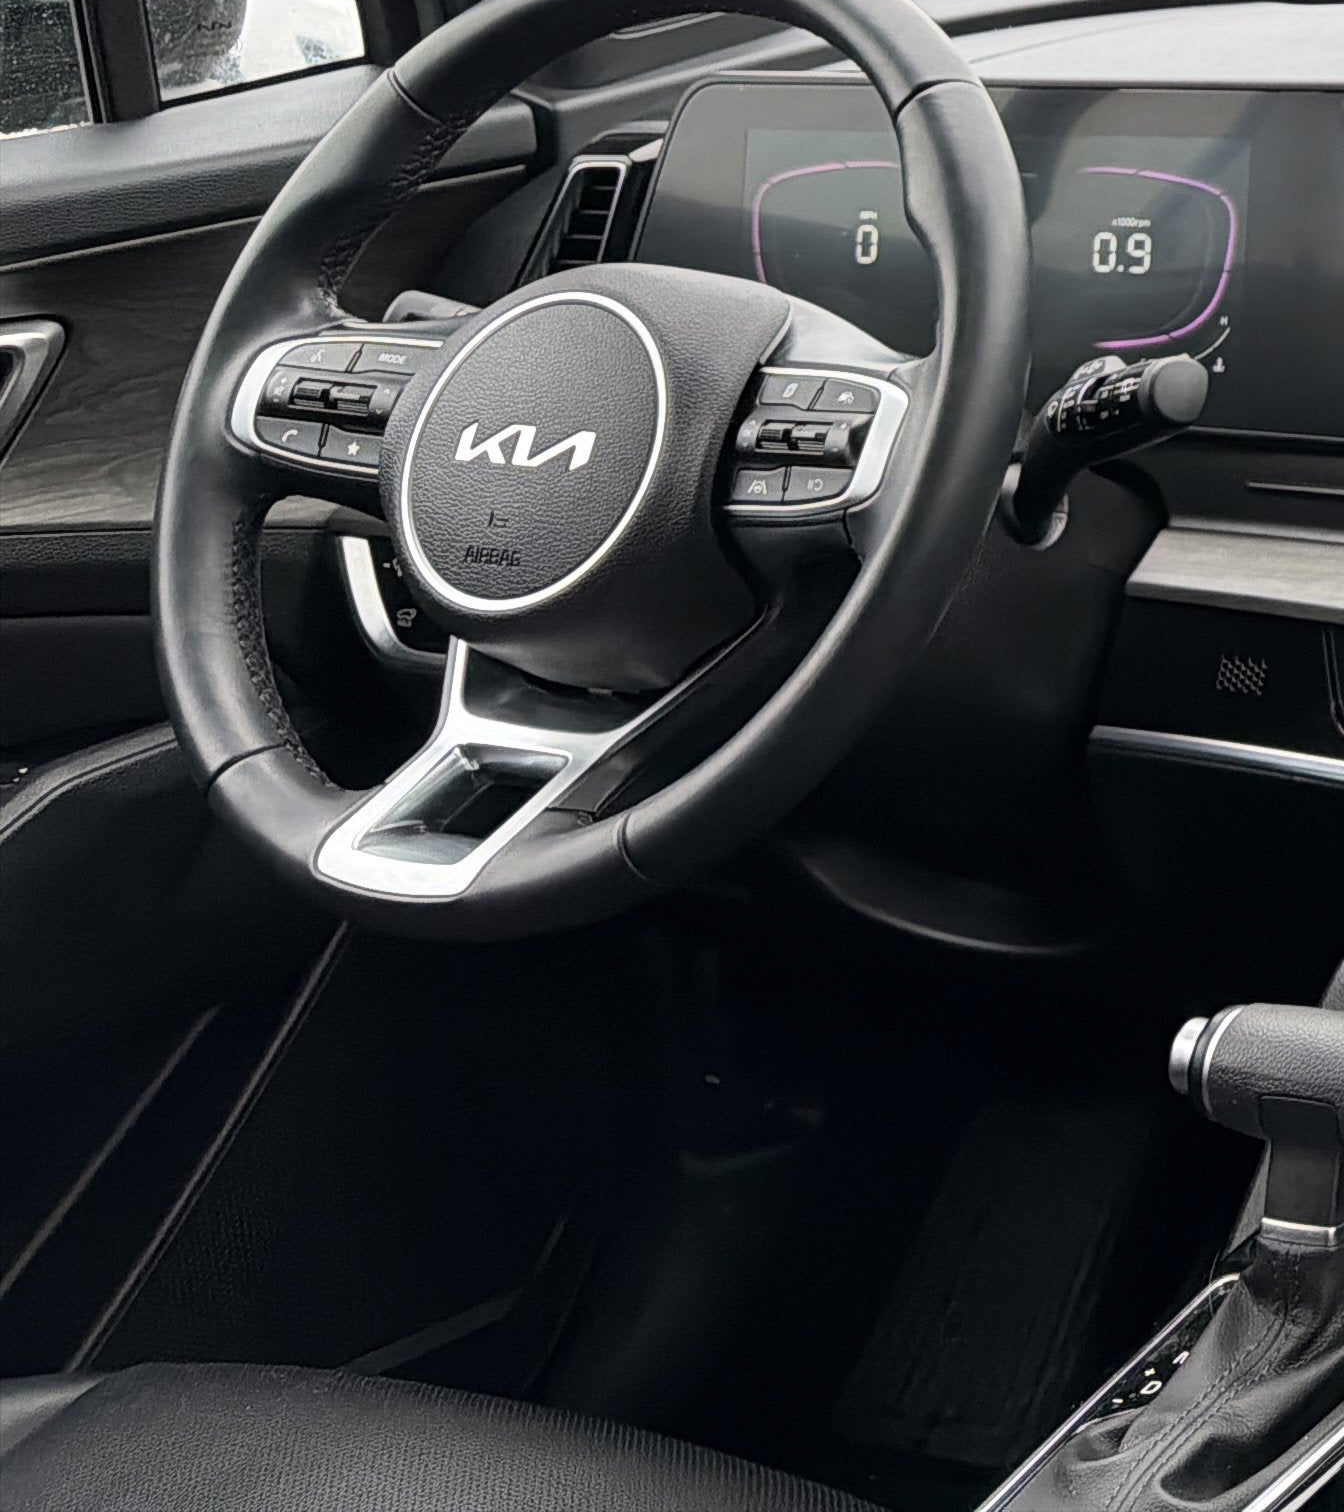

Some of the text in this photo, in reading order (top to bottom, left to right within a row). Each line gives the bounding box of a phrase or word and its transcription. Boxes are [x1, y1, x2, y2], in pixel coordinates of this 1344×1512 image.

[855, 224, 879, 265] 0
[1092, 231, 1152, 274] 0.9
[378, 352, 407, 365] MODE
[454, 421, 597, 472] KIA
[463, 544, 521, 567] AIRBAG
